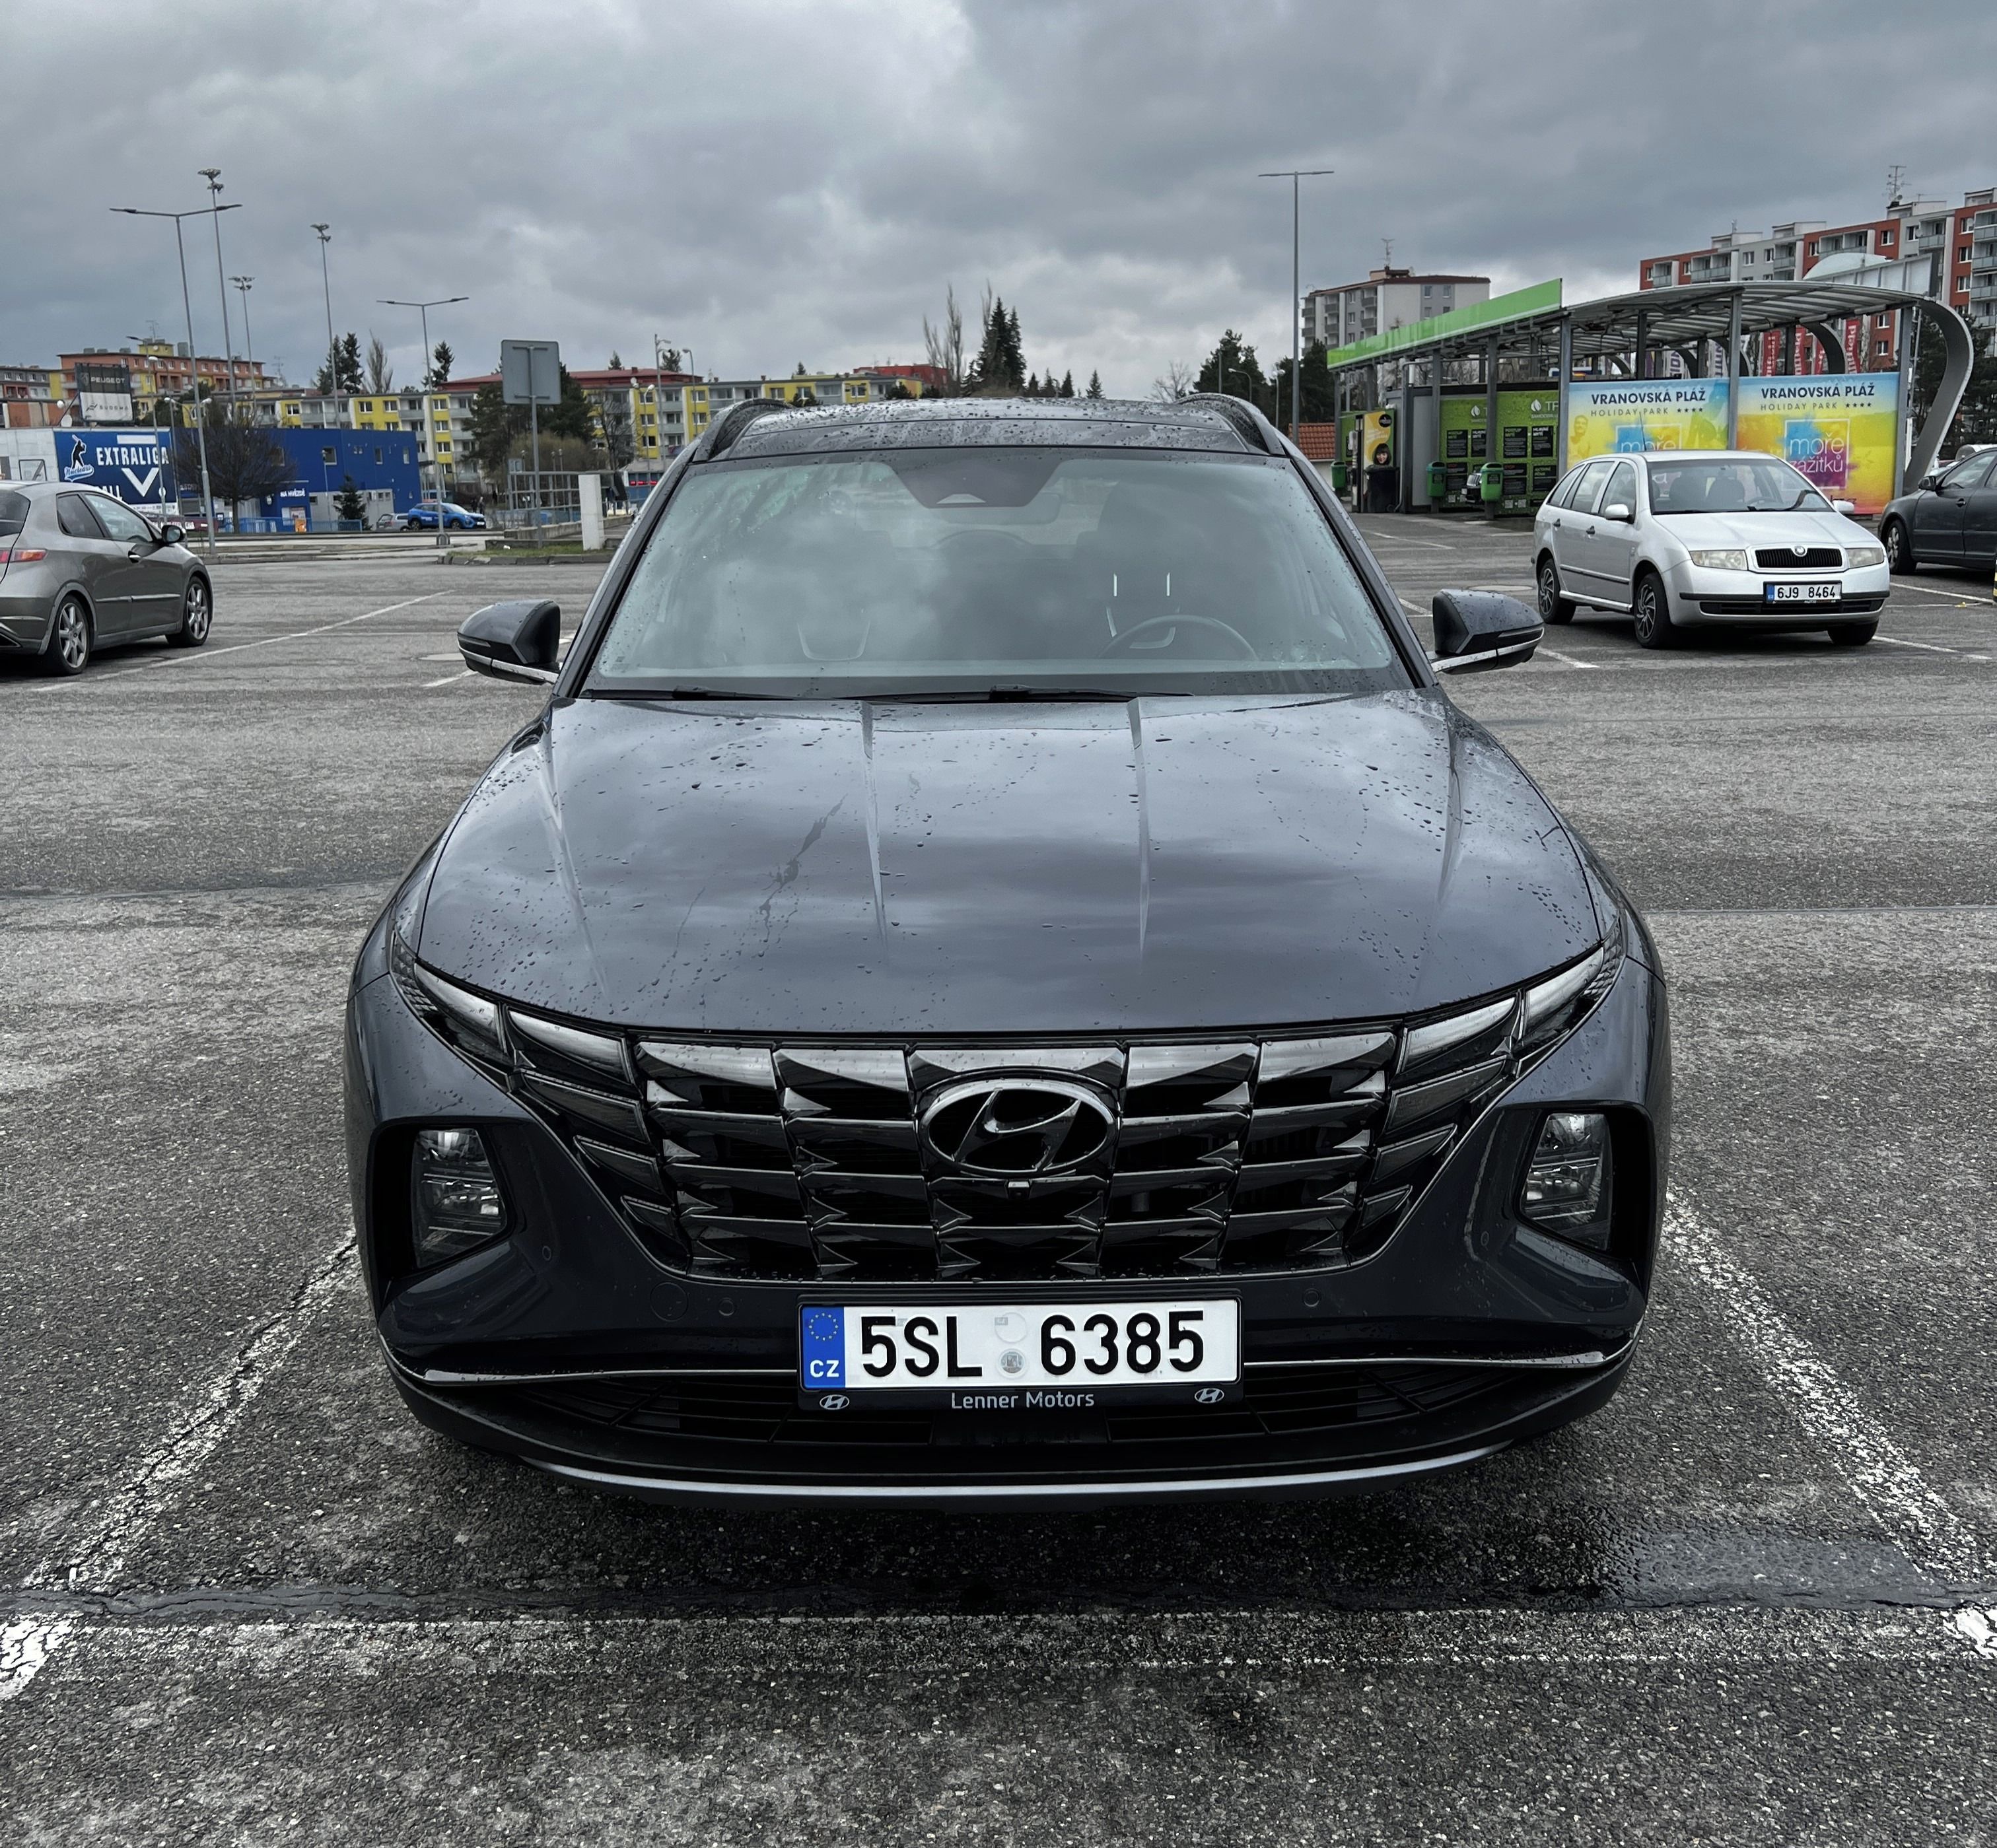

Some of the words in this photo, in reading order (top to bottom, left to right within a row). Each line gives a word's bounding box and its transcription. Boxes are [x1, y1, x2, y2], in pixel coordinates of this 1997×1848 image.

[1591, 389, 1671, 405] VRANOVSKÁ
[1676, 388, 1706, 401] PLÁŽ
[1761, 383, 1840, 399] VRANOVSKÁ
[1845, 382, 1875, 396] PLÁŽ
[1591, 408, 1638, 417] HOLIDAY
[1761, 402, 1807, 411] HOLIDAY
[1813, 402, 1838, 411] PARK
[1790, 432, 1844, 455] moře
[96, 447, 170, 465] EXTRALIGA
[1777, 586, 1799, 599] 6J9
[1808, 586, 1836, 599] 8464
[860, 1315, 983, 1378] 5SL
[1040, 1310, 1205, 1376] 6385
[810, 1359, 840, 1378] CZ
[951, 1391, 1019, 1410] Lenner
[1026, 1390, 1095, 1408] Motors
